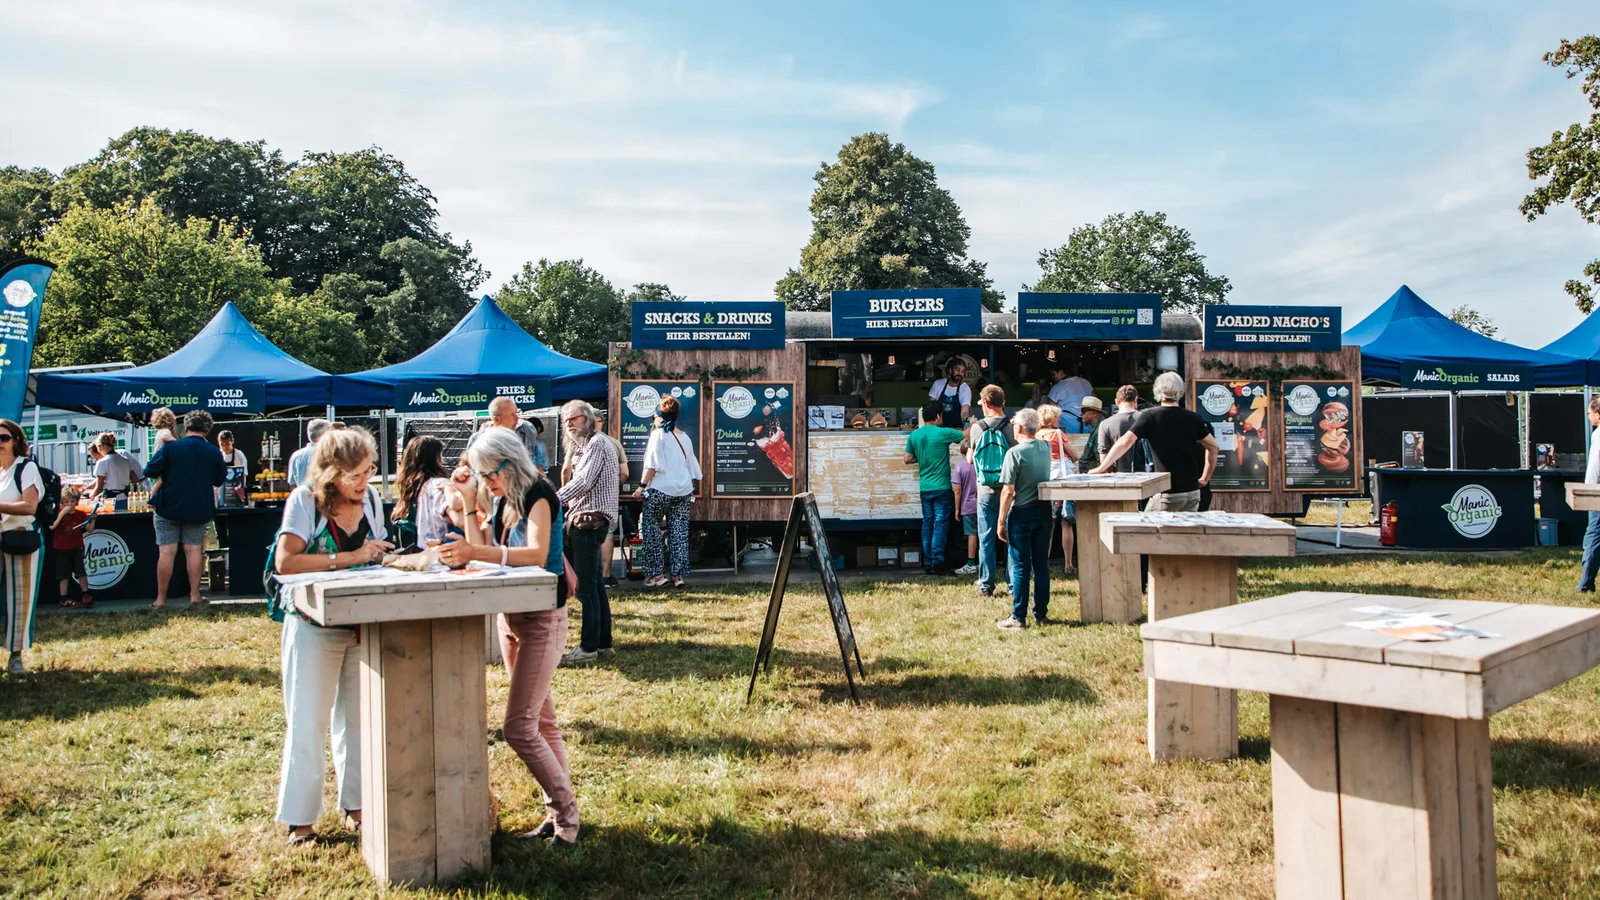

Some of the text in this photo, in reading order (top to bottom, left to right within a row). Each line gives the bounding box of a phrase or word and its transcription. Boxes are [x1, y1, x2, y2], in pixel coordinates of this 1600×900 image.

[868, 297, 945, 313] BURGERS
[644, 312, 773, 325] SNACKS & DRINKS
[866, 317, 949, 329] HIER BESTELLEN!
[1216, 315, 1331, 328] LOADED NACHO'S
[665, 332, 751, 341] HIER BESTELLEN!
[1235, 334, 1312, 343] HIER BESTELLEN!
[1487, 373, 1520, 382] SALADS
[213, 389, 244, 398] COLD
[495, 385, 536, 395] FRIES &
[634, 392, 655, 402] Manic
[727, 393, 749, 403] Manic
[1208, 391, 1227, 401] Manic
[1294, 391, 1314, 401] Manic
[207, 398, 249, 408] DRINKS
[622, 422, 649, 433] Haute
[715, 428, 743, 440] Drinks
[1456, 495, 1490, 513] Manic
[1449, 506, 1501, 524] Organic
